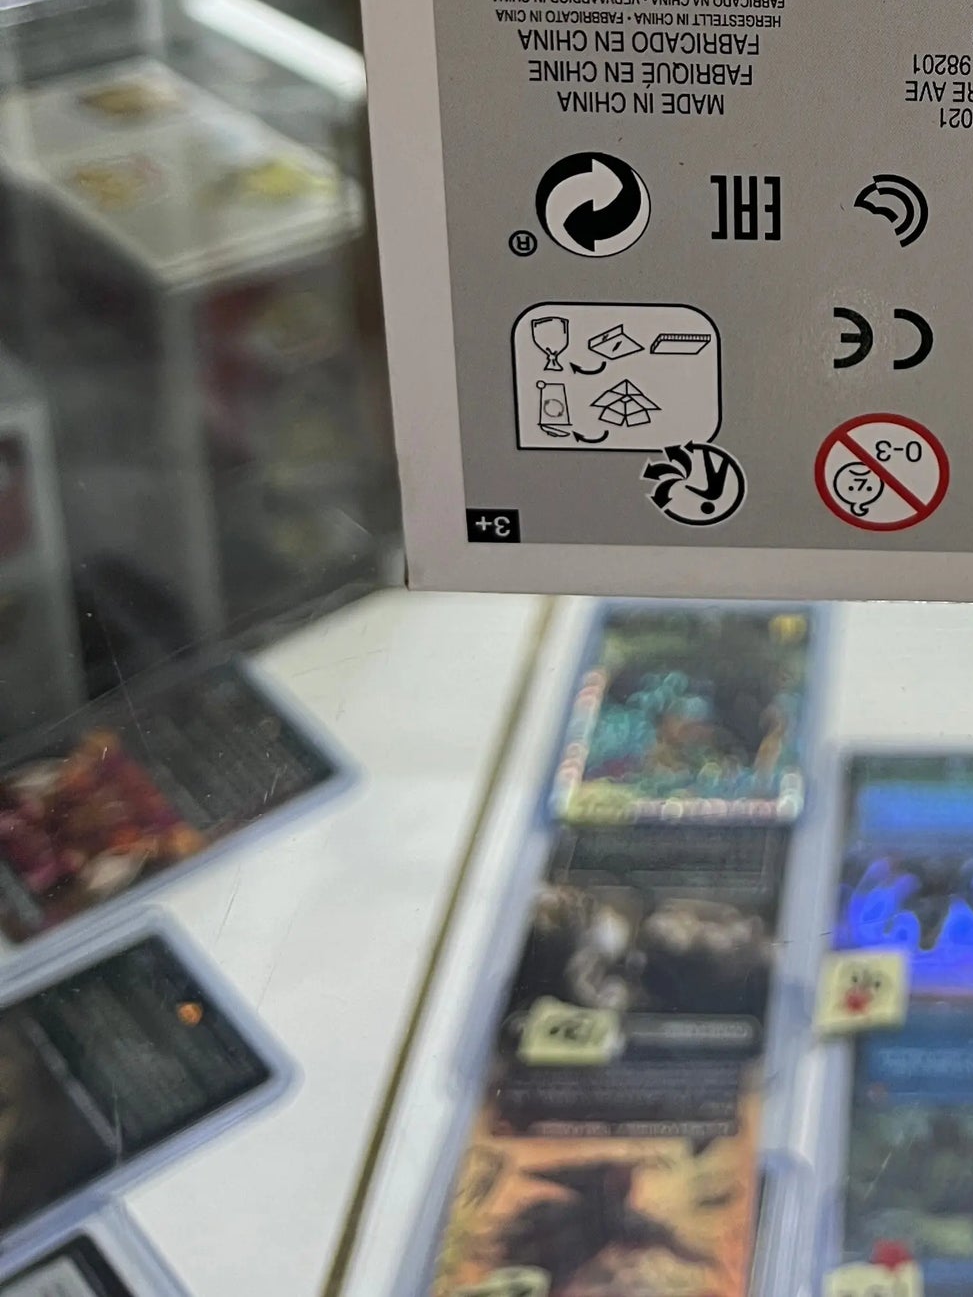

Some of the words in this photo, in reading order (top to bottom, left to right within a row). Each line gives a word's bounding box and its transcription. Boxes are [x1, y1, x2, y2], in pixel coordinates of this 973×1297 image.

[494, 8, 526, 23] CINA
[529, 9, 542, 22] IN
[544, 9, 624, 24] FABBRICATO
[633, 11, 673, 26] CHINA
[676, 12, 689, 25] IN
[693, 13, 781, 28] HERGESTELLT
[516, 28, 587, 52] CHINA
[594, 29, 624, 52] EN
[631, 30, 759, 55] FABRICADO
[527, 59, 597, 83] CHINE
[604, 60, 634, 83] EN
[640, 61, 752, 87] FABRIQUÉ
[912, 53, 971, 76] 98201
[556, 90, 626, 114] CHINA
[904, 79, 947, 102] AVE
[632, 91, 653, 114] IN
[661, 92, 724, 115] MADE
[709, 173, 781, 240] EAC
[873, 437, 923, 462] 0-3
[474, 514, 511, 536] 3+
